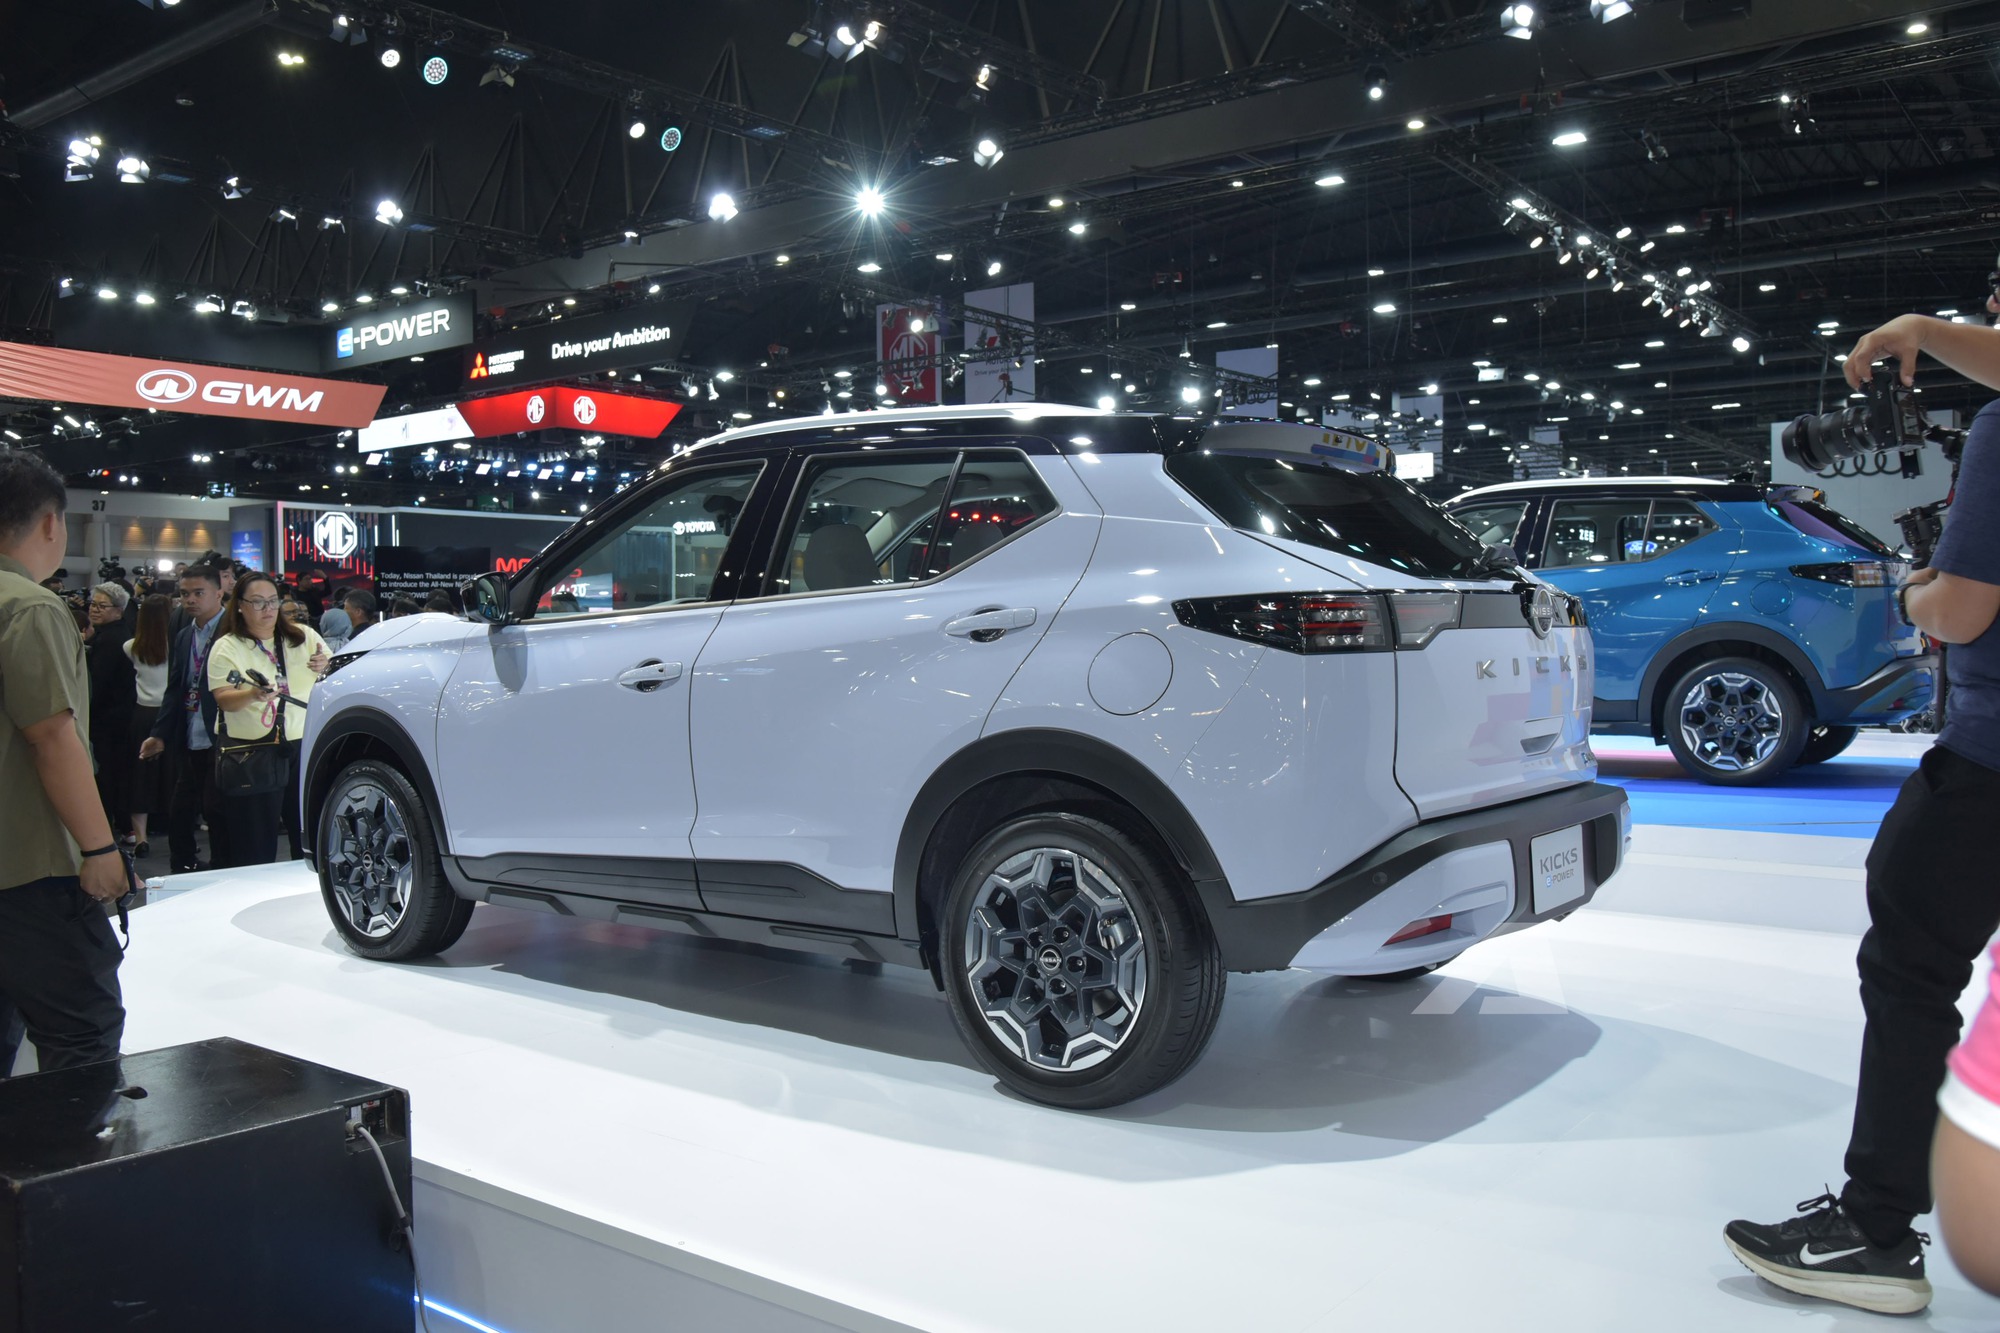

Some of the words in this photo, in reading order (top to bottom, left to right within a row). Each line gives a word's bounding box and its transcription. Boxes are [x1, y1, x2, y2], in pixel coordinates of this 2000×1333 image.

[337, 308, 451, 356] e-POWER
[551, 341, 582, 359] Drive
[584, 337, 612, 358] your
[612, 325, 670, 349] Ambition
[202, 380, 324, 412] GWM
[527, 395, 545, 424] MG
[574, 396, 597, 424] MG
[92, 500, 106, 511] 37
[315, 512, 357, 558] MG
[685, 521, 716, 533] TOYOTA
[380, 572, 402, 581] Today,
[1476, 655, 1588, 680] KICKS
[1540, 848, 1578, 875] KICKS
[1546, 868, 1575, 888] e-POWER
